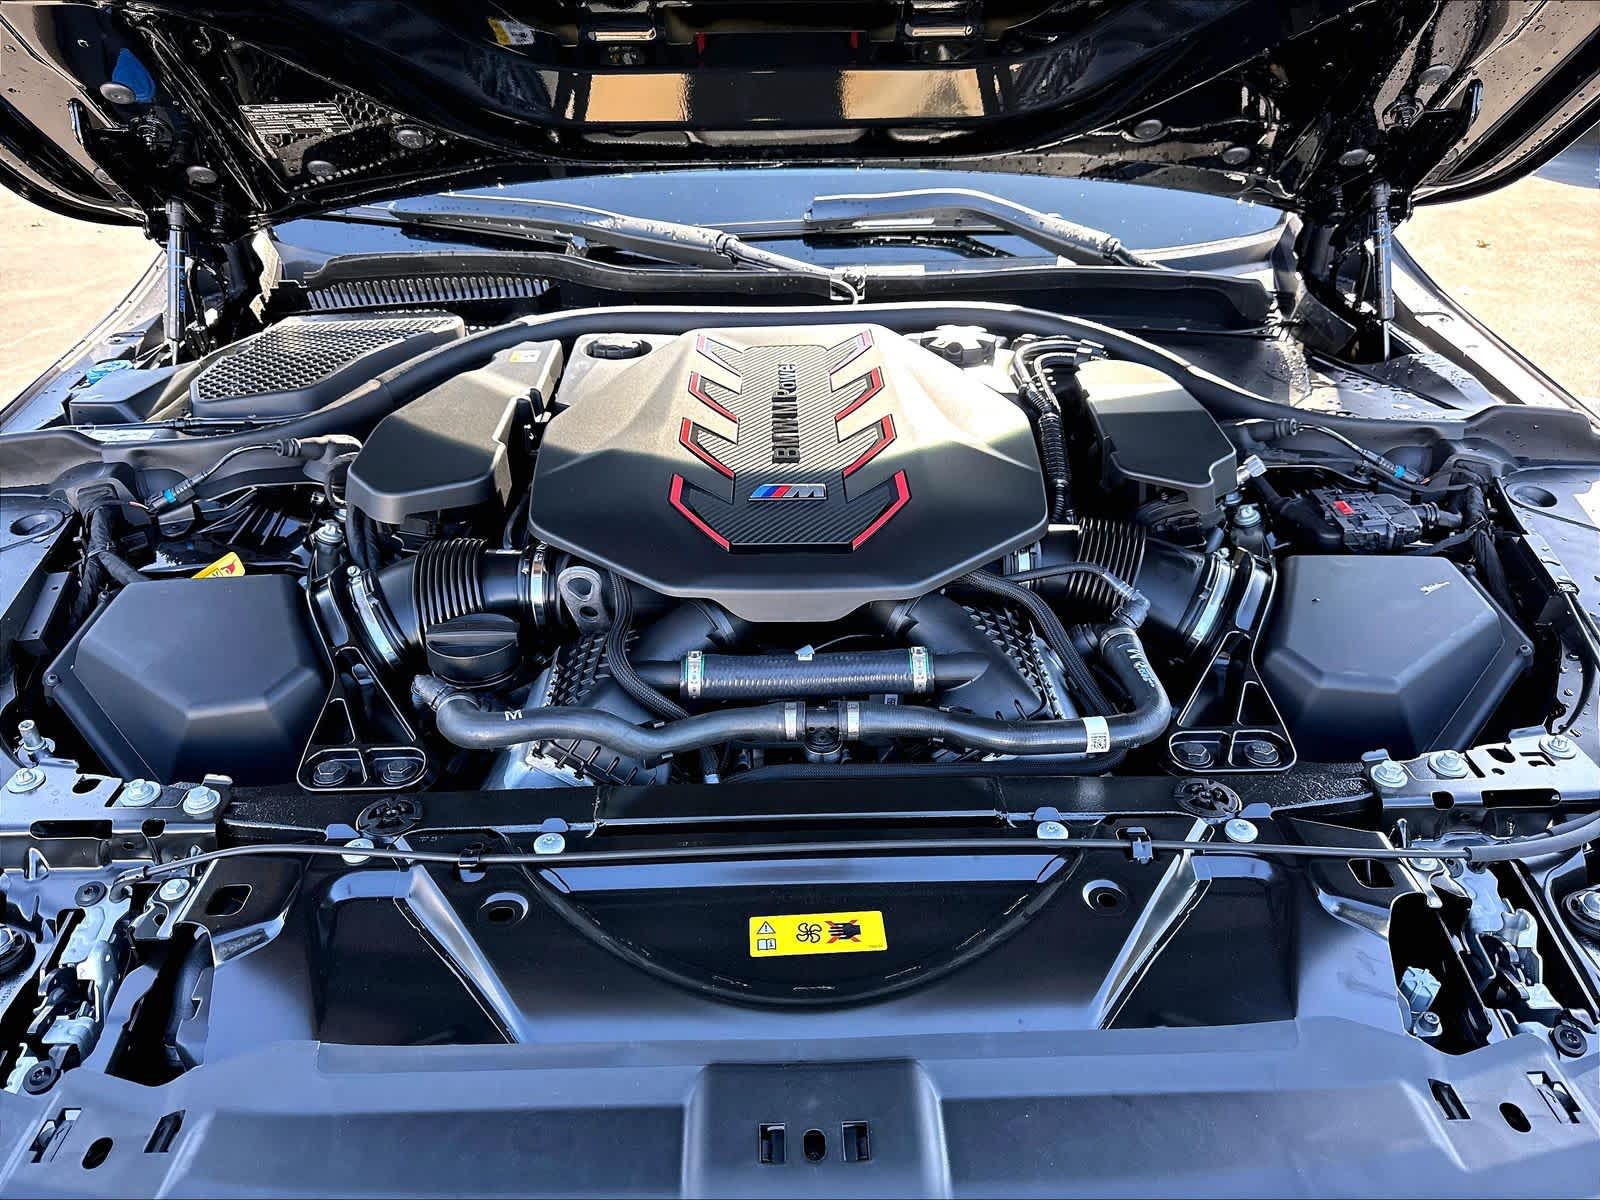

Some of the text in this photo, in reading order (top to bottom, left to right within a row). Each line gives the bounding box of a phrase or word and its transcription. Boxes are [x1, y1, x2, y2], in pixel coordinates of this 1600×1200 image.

[772, 419, 800, 464] BMW
[783, 484, 825, 498] M
[504, 709, 523, 721] M
